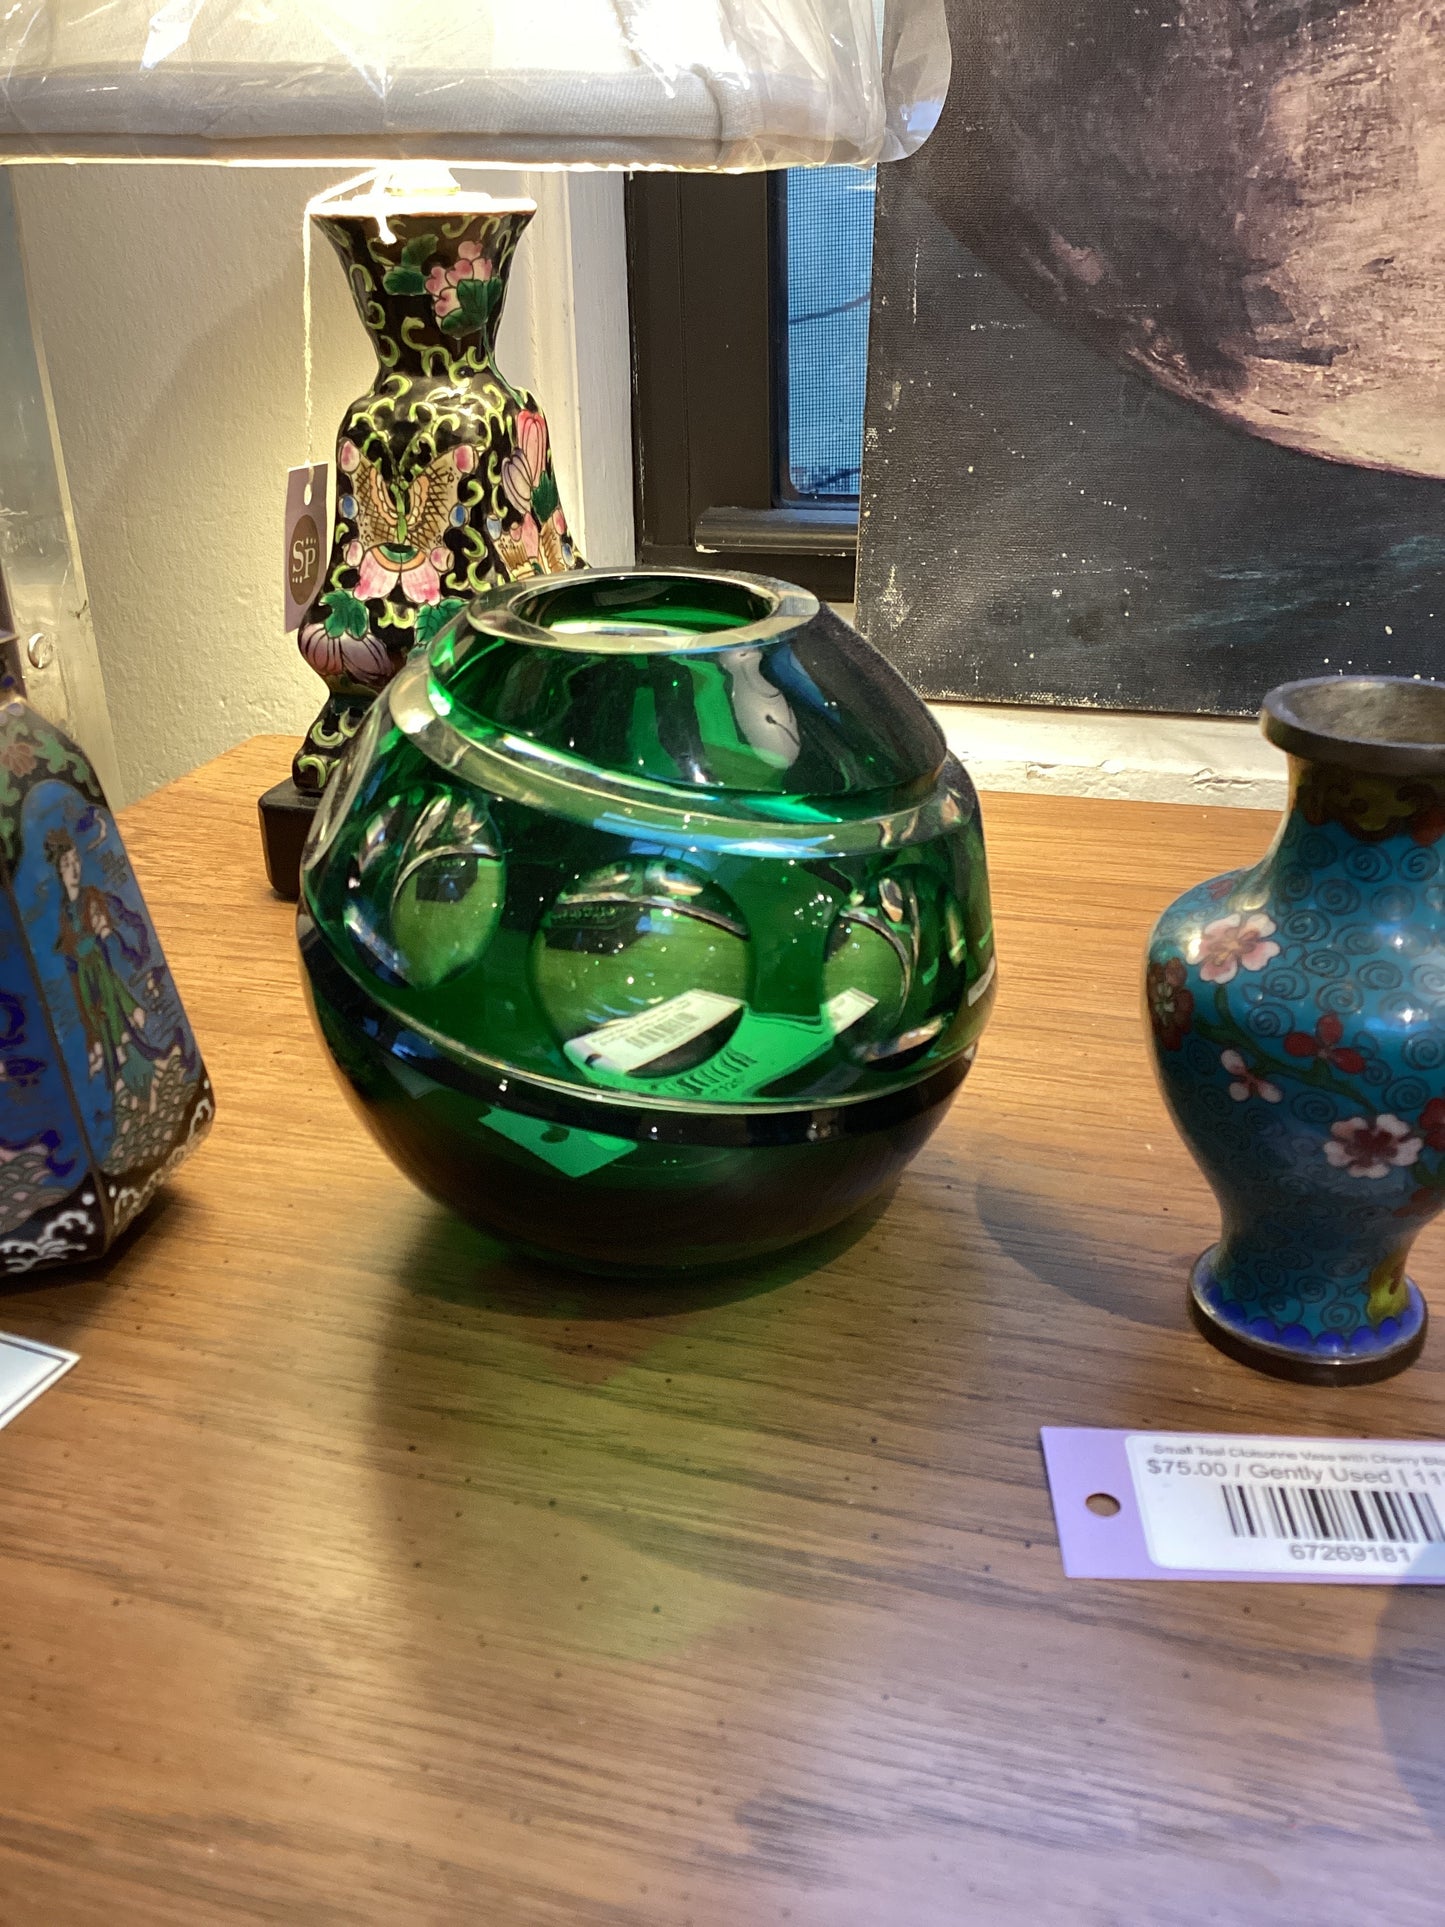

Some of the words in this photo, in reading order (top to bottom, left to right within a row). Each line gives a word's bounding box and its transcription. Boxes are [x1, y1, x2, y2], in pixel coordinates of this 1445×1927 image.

[1147, 1459, 1227, 1478] $75.00
[1249, 1464, 1323, 1484] Gently
[1328, 1467, 1393, 1484] Used
[1290, 1544, 1410, 1563] 67269181
